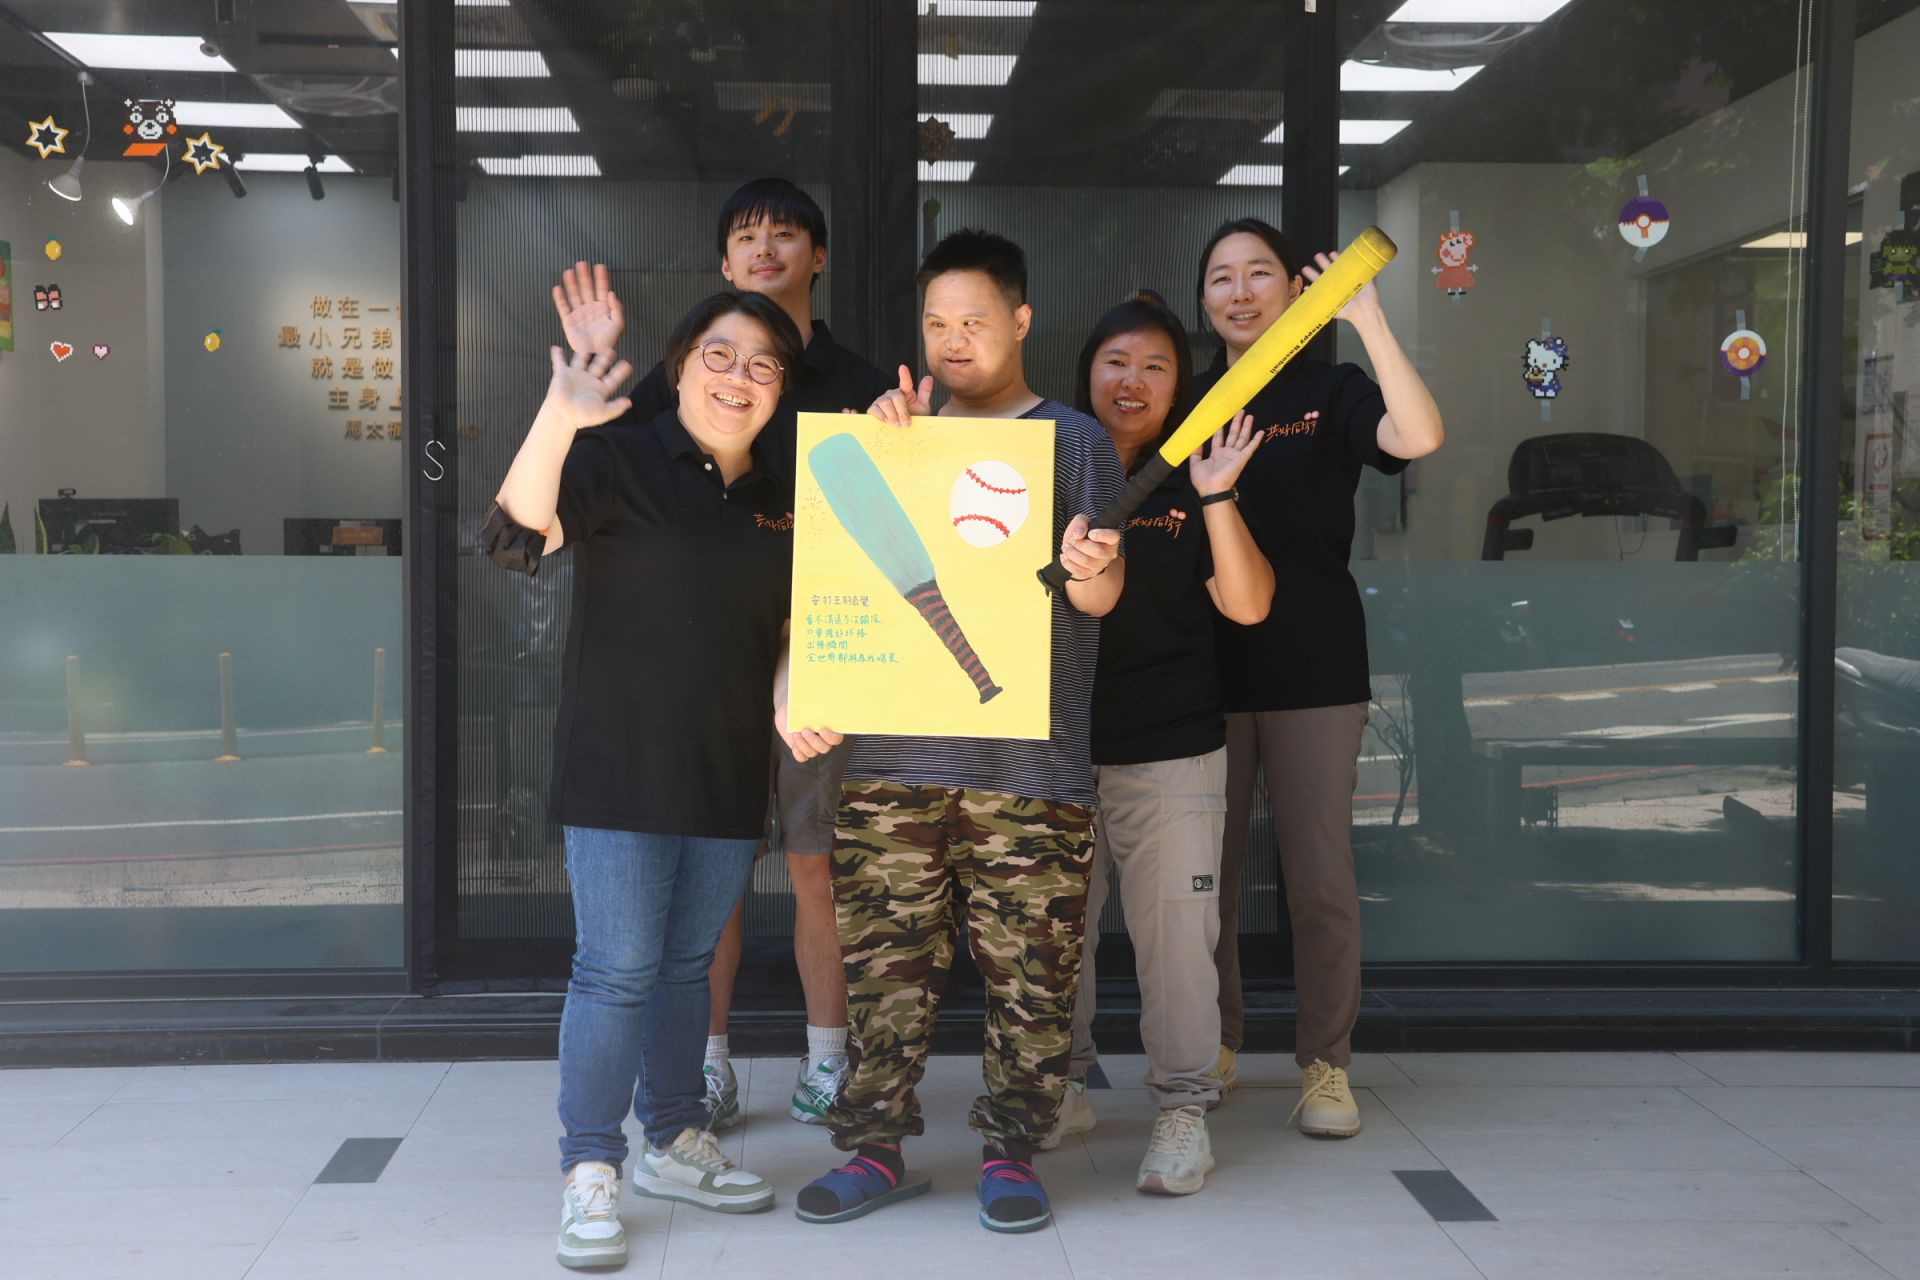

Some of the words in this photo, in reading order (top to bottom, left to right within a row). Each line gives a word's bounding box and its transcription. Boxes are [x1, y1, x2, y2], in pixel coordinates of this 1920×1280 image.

[310, 296, 402, 319] 做在一
[1300, 322, 1323, 344] Happy
[1270, 345, 1301, 374] Baseball
